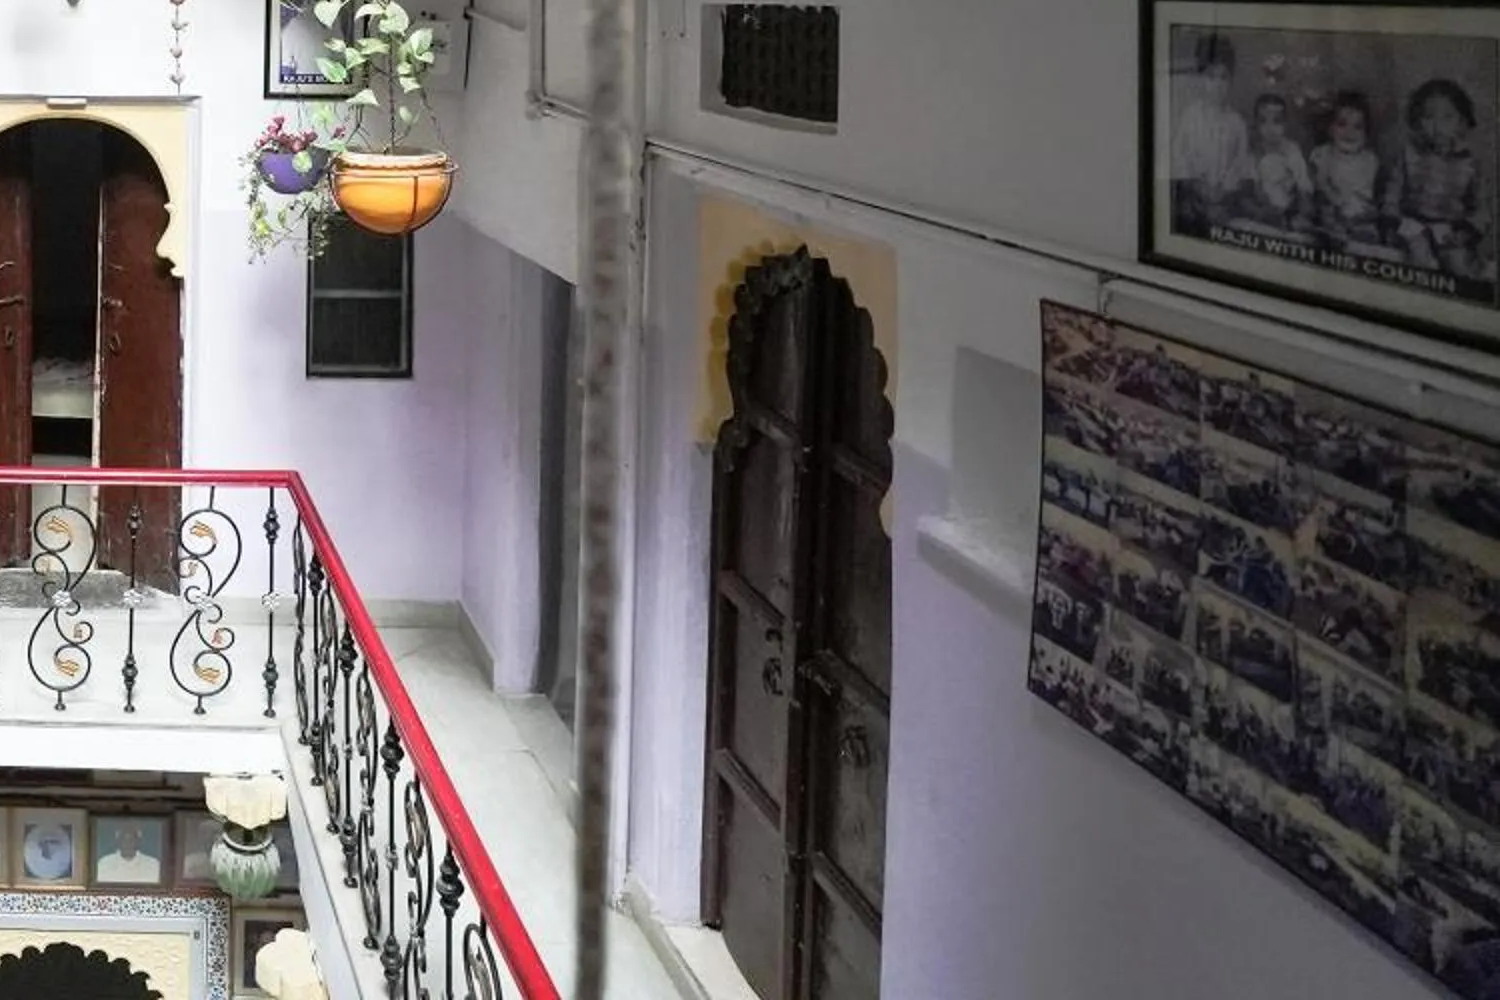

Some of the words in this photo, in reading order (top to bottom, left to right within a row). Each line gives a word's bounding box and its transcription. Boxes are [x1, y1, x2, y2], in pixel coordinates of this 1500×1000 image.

[1210, 226, 1259, 248] RAJU
[1321, 250, 1357, 271] HIS
[1363, 260, 1456, 293] COUSIN
